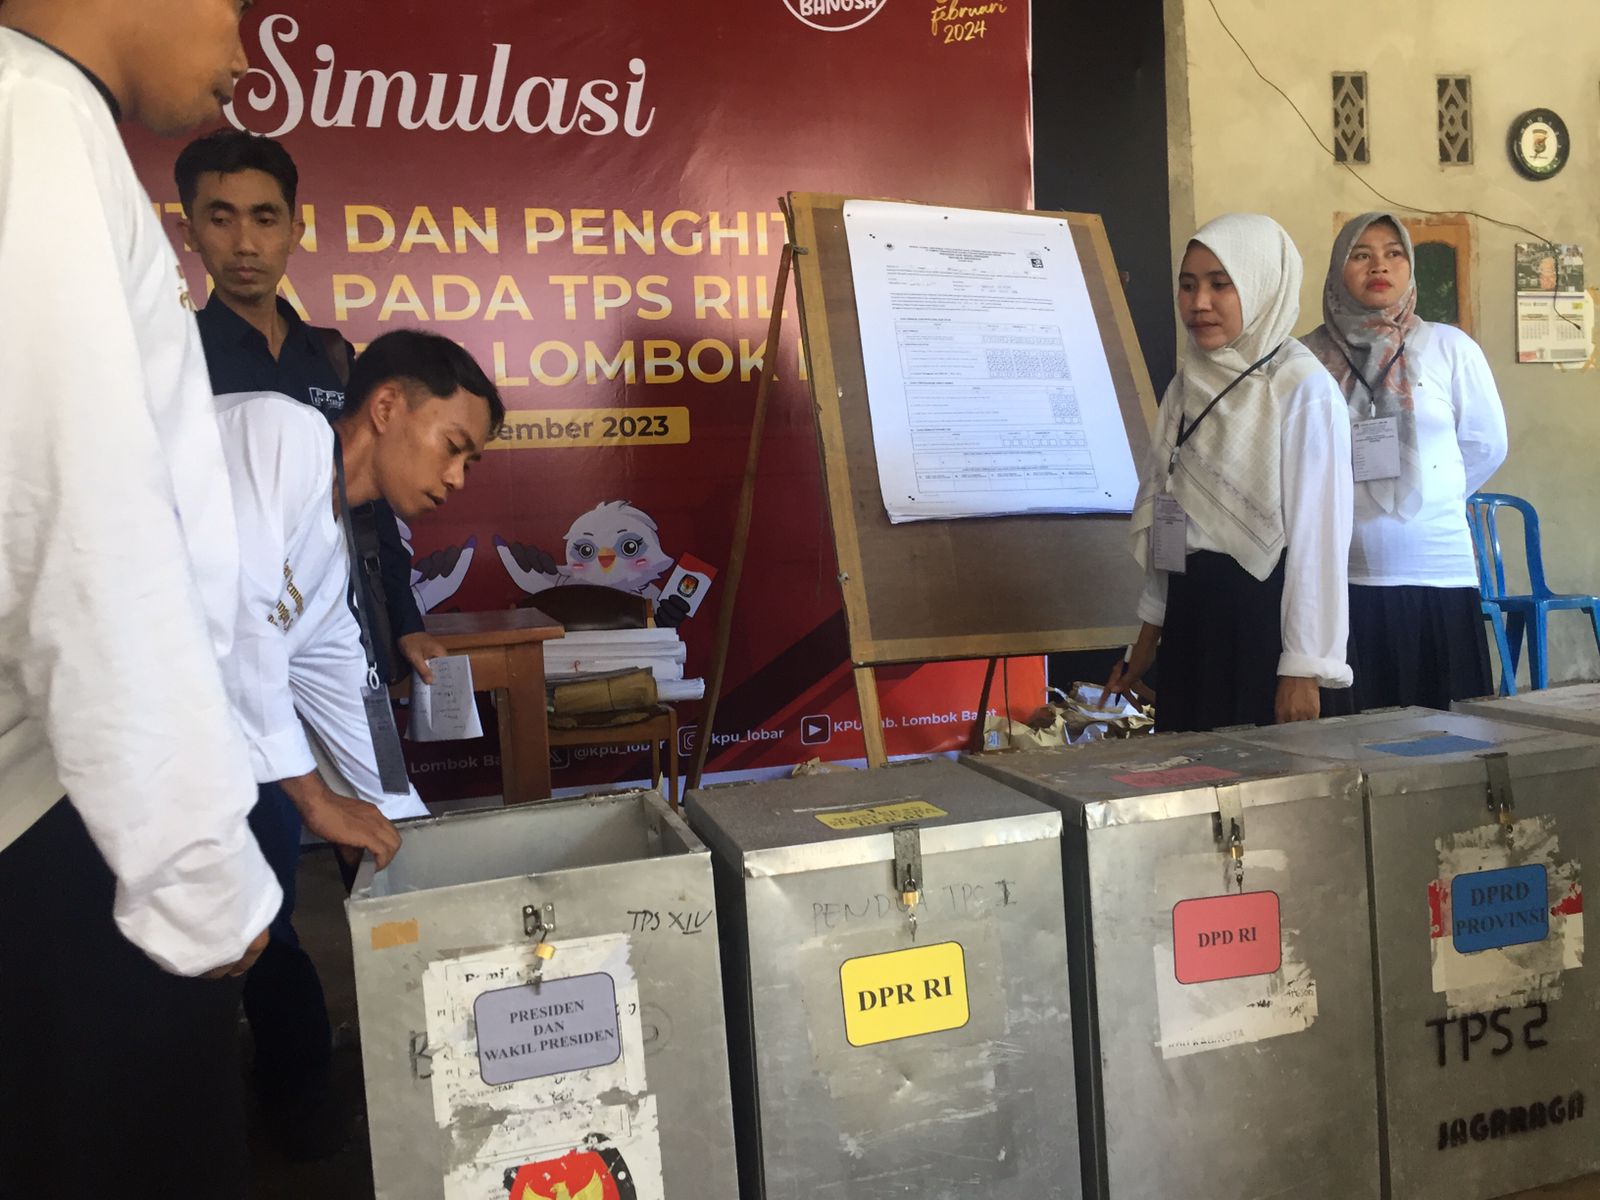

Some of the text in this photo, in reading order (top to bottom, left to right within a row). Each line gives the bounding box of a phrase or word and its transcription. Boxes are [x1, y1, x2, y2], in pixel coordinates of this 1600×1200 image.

[931, 0, 1008, 36] Februari
[943, 20, 987, 44] 2024
[222, 13, 656, 138] Simulasi
[344, 204, 499, 255] DAN
[332, 273, 534, 322] PADA
[549, 274, 673, 321] TPS
[494, 337, 780, 387] LOMBOK
[486, 415, 670, 442] ember 2023
[833, 719, 863, 733] KPU
[902, 711, 957, 727] Lombok
[711, 727, 785, 746] kpu_lobar
[574, 740, 666, 761] @kpu_lobr
[410, 755, 478, 774] Lombok
[1471, 881, 1530, 907] DPRD
[627, 909, 713, 935] TPS XIV
[1456, 907, 1547, 937] PROVINSI
[1198, 926, 1257, 948] DPD RI
[857, 975, 953, 1012] DPR RI
[509, 1000, 585, 1024] PRESIDEN
[533, 1020, 566, 1036] DAN
[484, 1028, 615, 1062] WAKIL PRESIDEN
